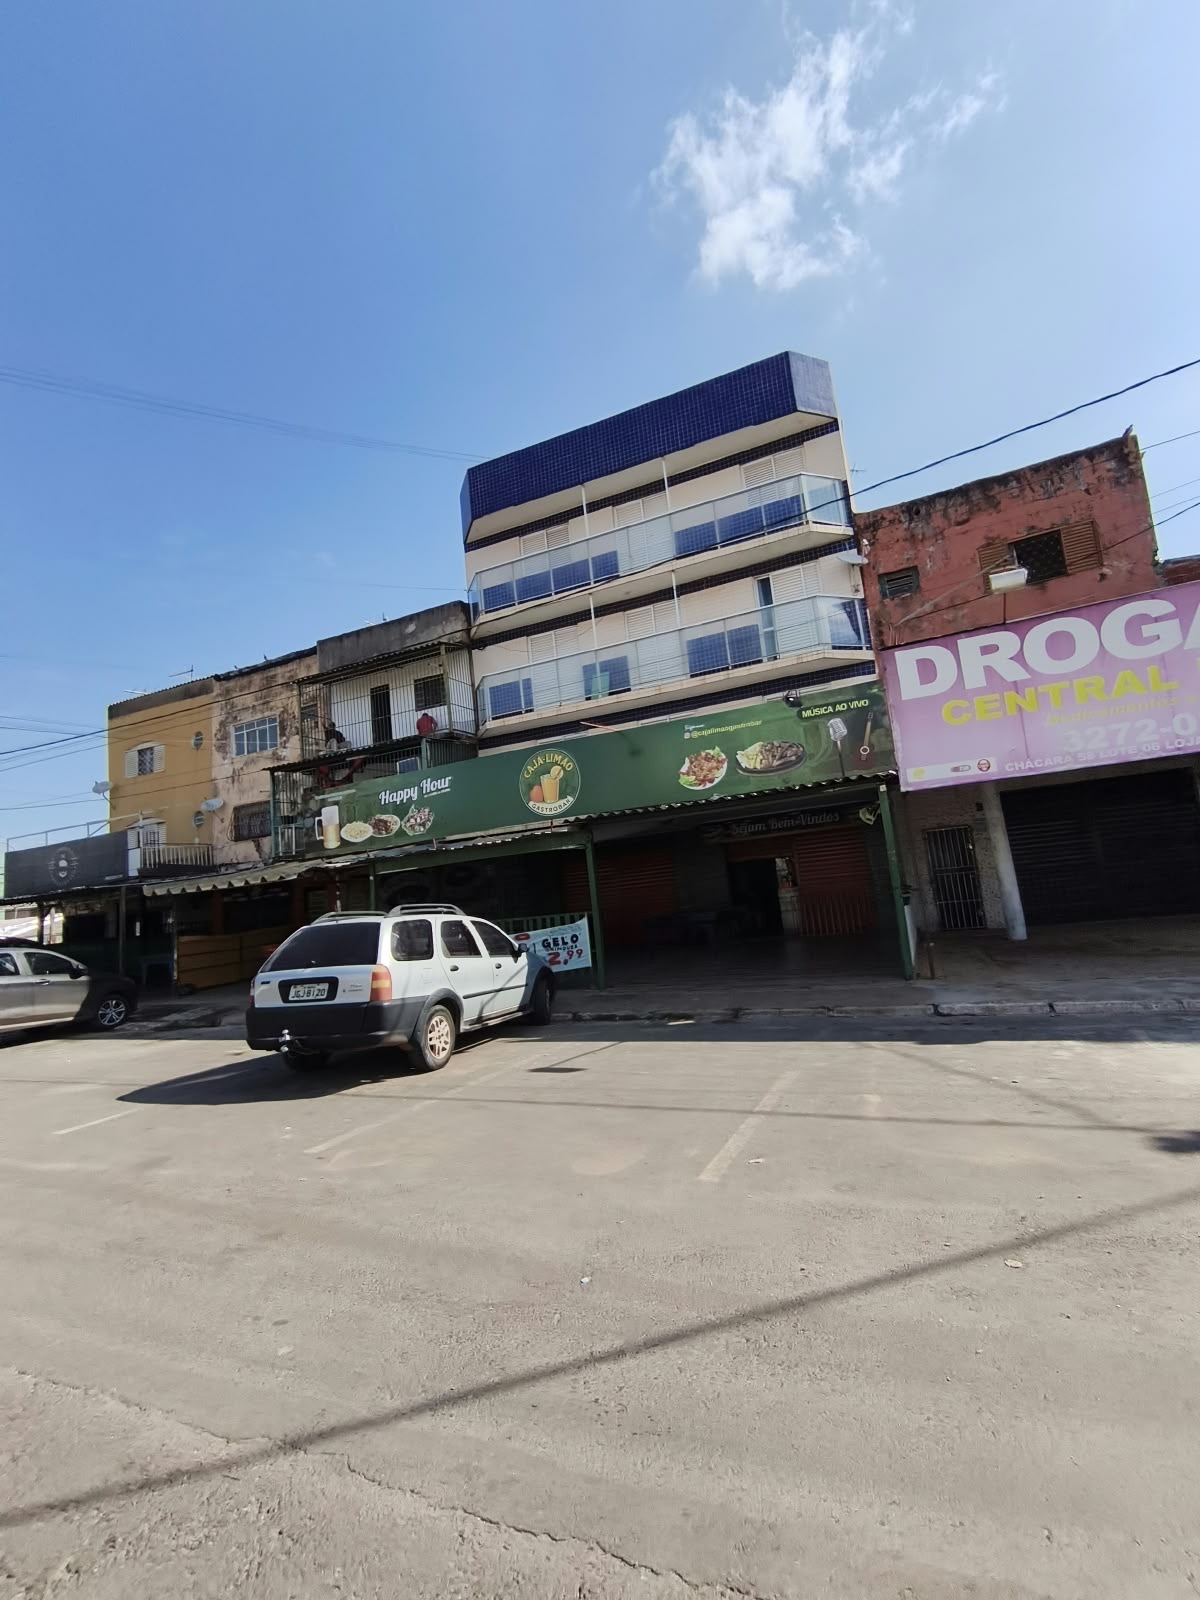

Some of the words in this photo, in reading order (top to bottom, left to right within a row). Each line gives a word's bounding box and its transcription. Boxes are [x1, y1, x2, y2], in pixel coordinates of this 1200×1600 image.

[894, 599, 1200, 701] DROG
[941, 665, 1180, 726] CENTRAL
[801, 704, 833, 718] MÚSICA
[835, 702, 848, 712] AO
[848, 699, 869, 709] VIVO
[379, 785, 418, 805] Happy
[420, 776, 452, 794] Hour
[531, 798, 571, 813] GASTROBAR
[541, 933, 579, 949] GELO
